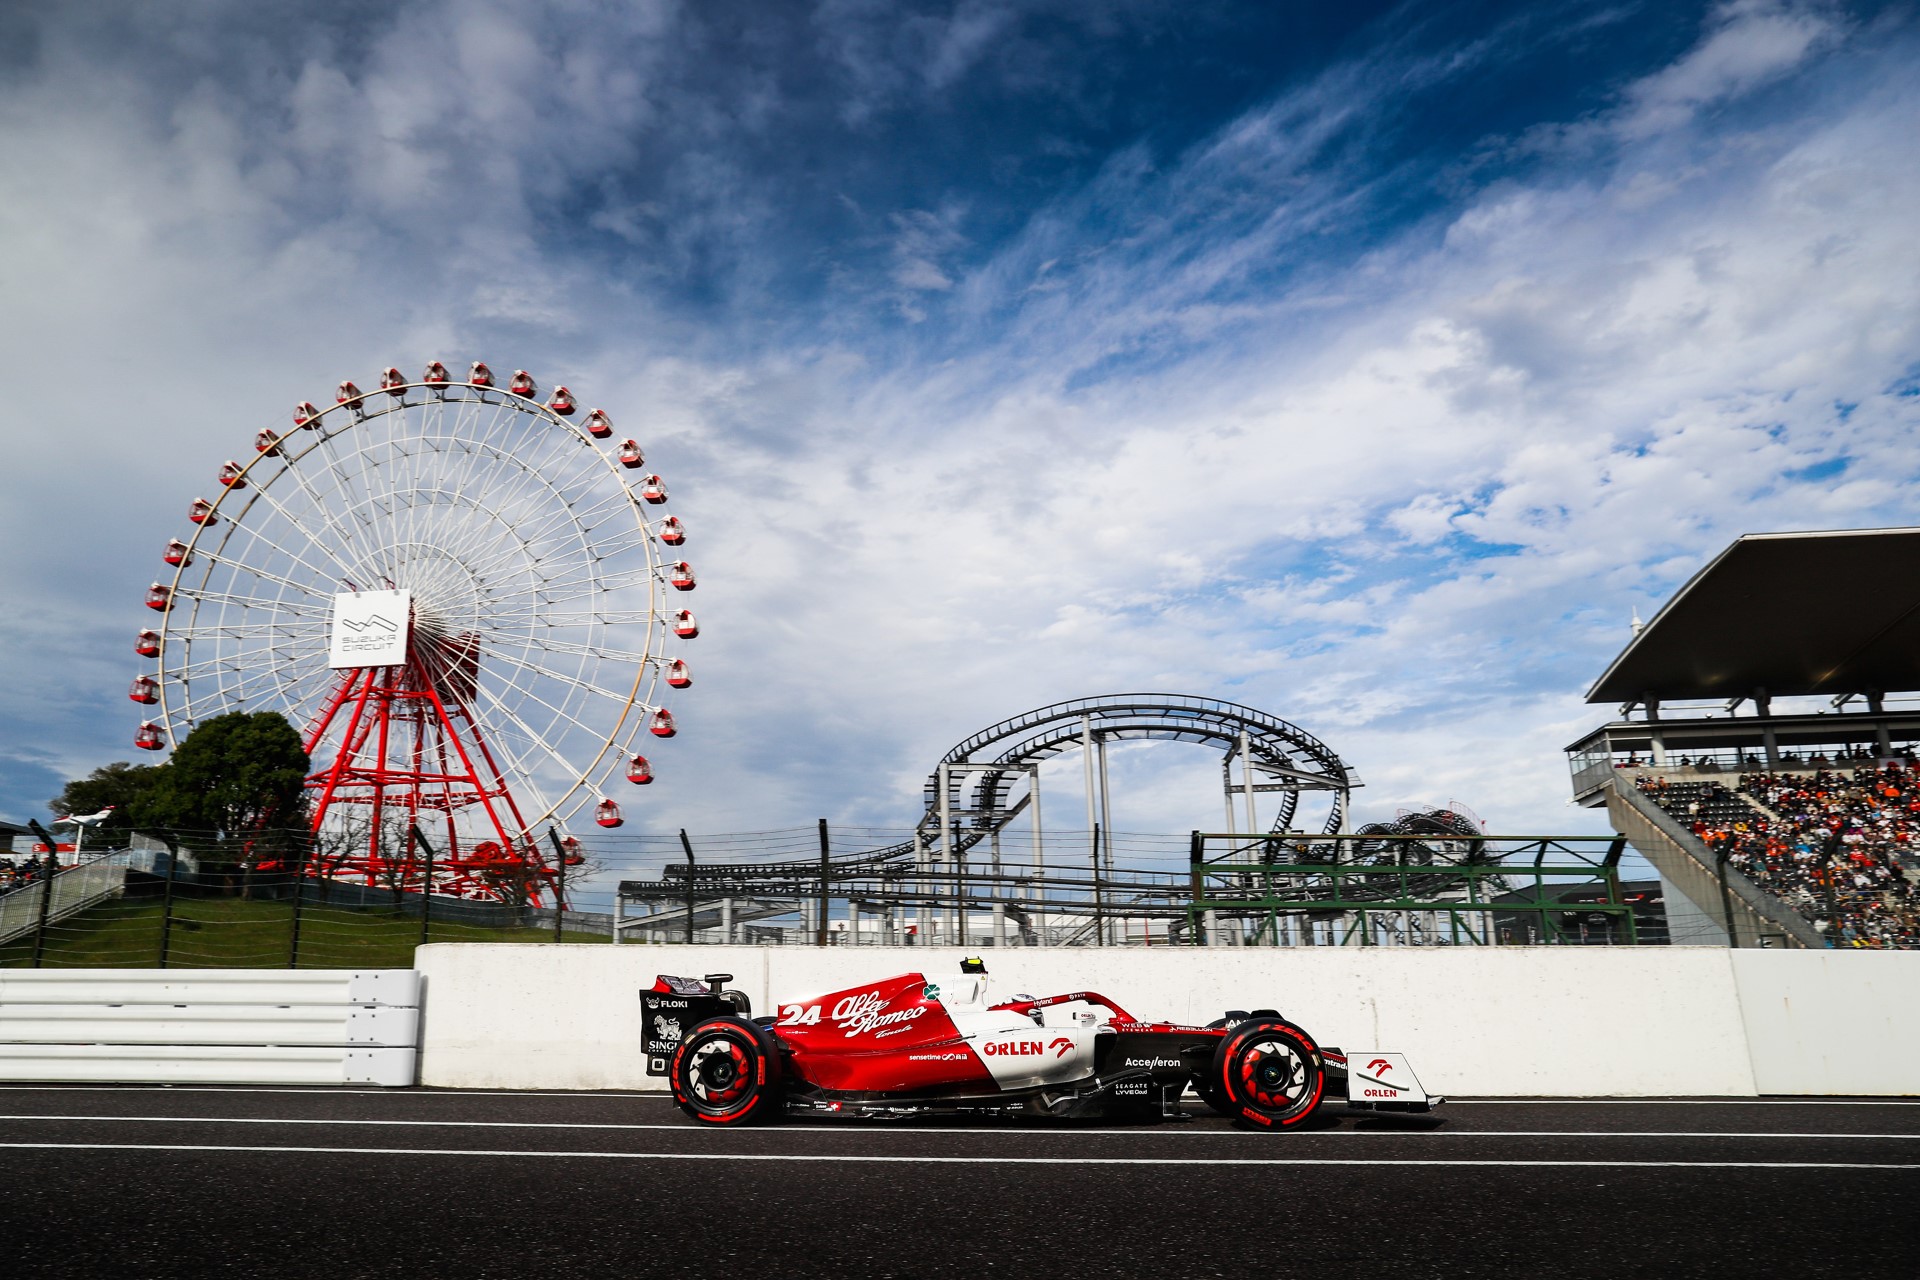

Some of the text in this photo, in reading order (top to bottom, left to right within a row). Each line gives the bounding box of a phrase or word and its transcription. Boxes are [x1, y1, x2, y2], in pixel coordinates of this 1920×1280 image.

[342, 634, 396, 643] SUZUKA
[342, 642, 394, 651] CIRCUIT
[831, 990, 890, 1020] Alfa
[1033, 998, 1053, 1006] Hyland
[777, 1004, 822, 1026] 24
[838, 1006, 927, 1038] Romeo
[1272, 1024, 1314, 1051] ZERO
[648, 1041, 678, 1050] SING
[983, 1041, 1043, 1056] ORLEN
[909, 1053, 941, 1061] sensetime
[1364, 1089, 1397, 1097] ORLEN
